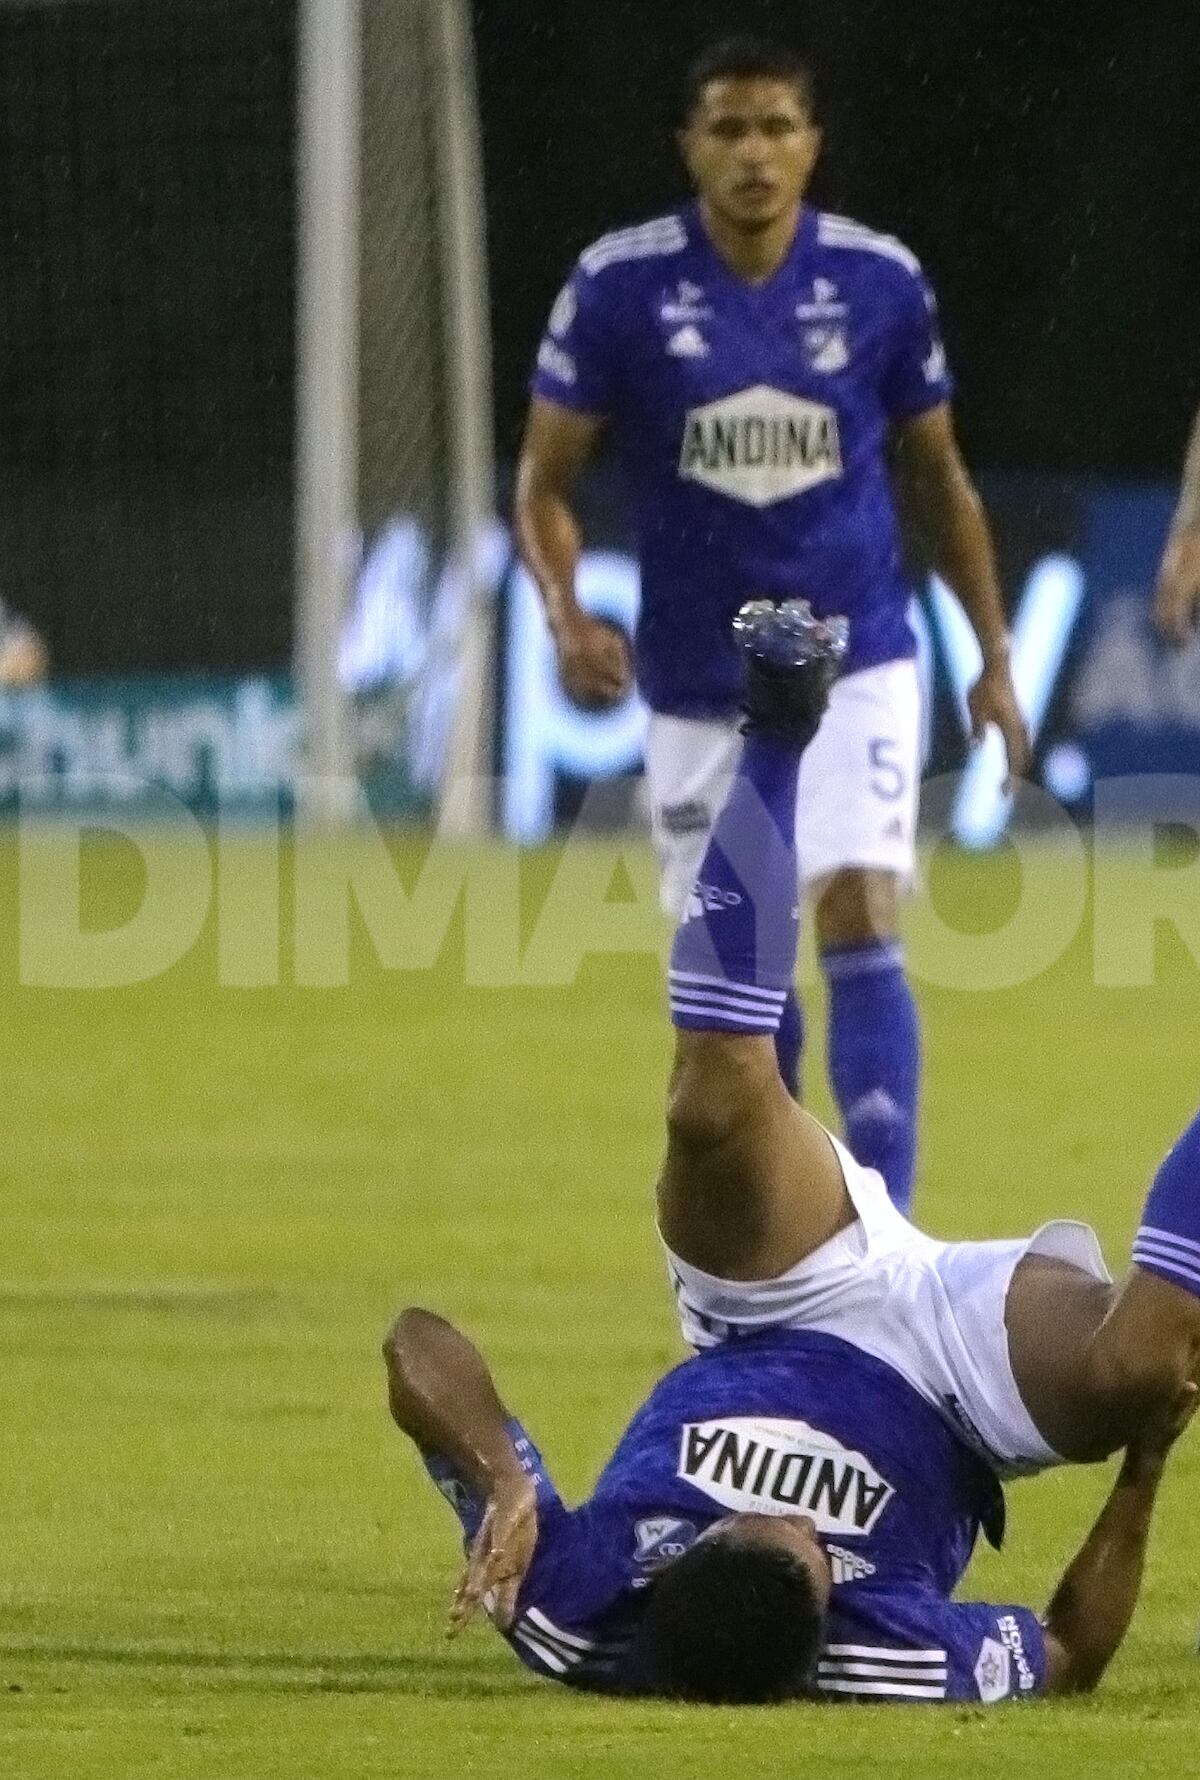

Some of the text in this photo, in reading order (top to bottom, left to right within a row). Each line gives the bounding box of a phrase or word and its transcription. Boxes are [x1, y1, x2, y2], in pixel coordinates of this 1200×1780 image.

[683, 414, 832, 470] ANDINA
[867, 736, 904, 803] 5
[685, 1426, 889, 1528] ANDINA
